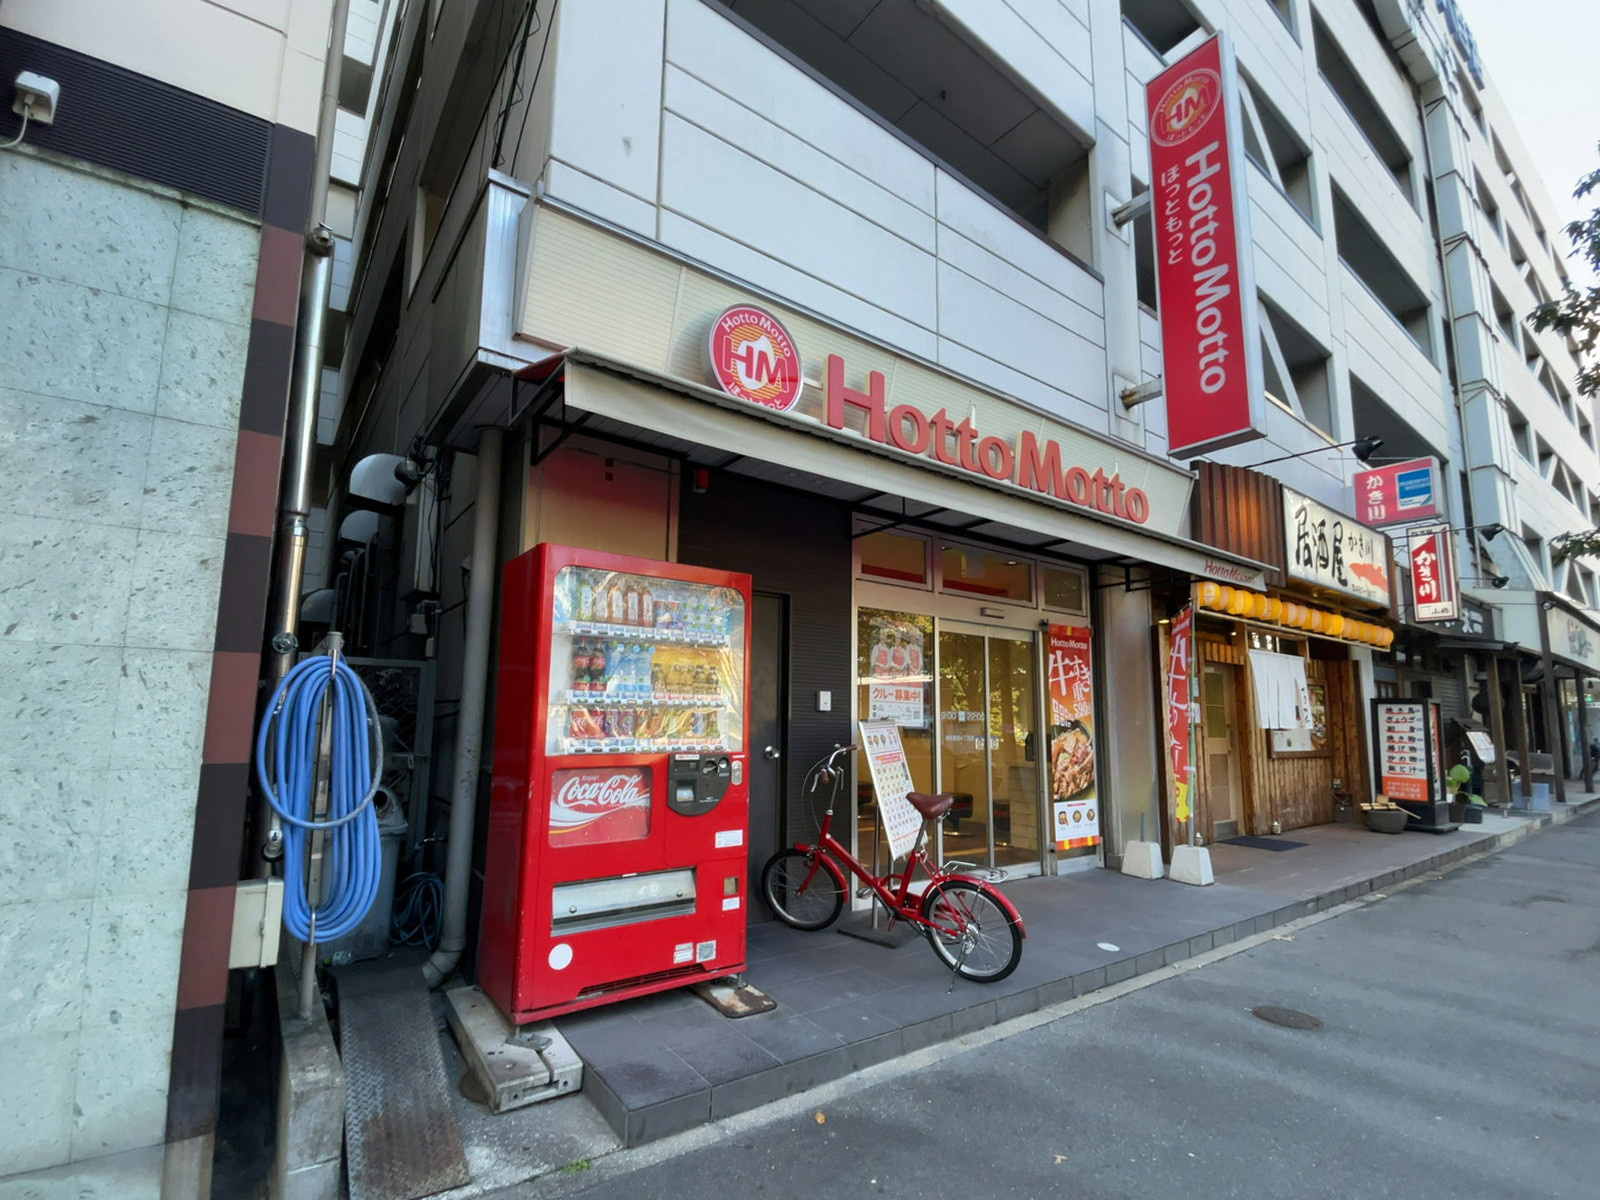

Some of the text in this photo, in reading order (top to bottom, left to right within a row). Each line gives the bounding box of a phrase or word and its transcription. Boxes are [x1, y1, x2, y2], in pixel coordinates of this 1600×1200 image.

[1160, 164, 1184, 265] ほっともっと
[1185, 140, 1231, 394] HottoMotto
[722, 335, 790, 394] HM
[822, 353, 1150, 525] HottoMotto
[1366, 475, 1386, 521] かき川
[1294, 505, 1348, 587] 居酒屋
[1414, 550, 1437, 601] かき川
[1051, 638, 1088, 649] HottoMotto
